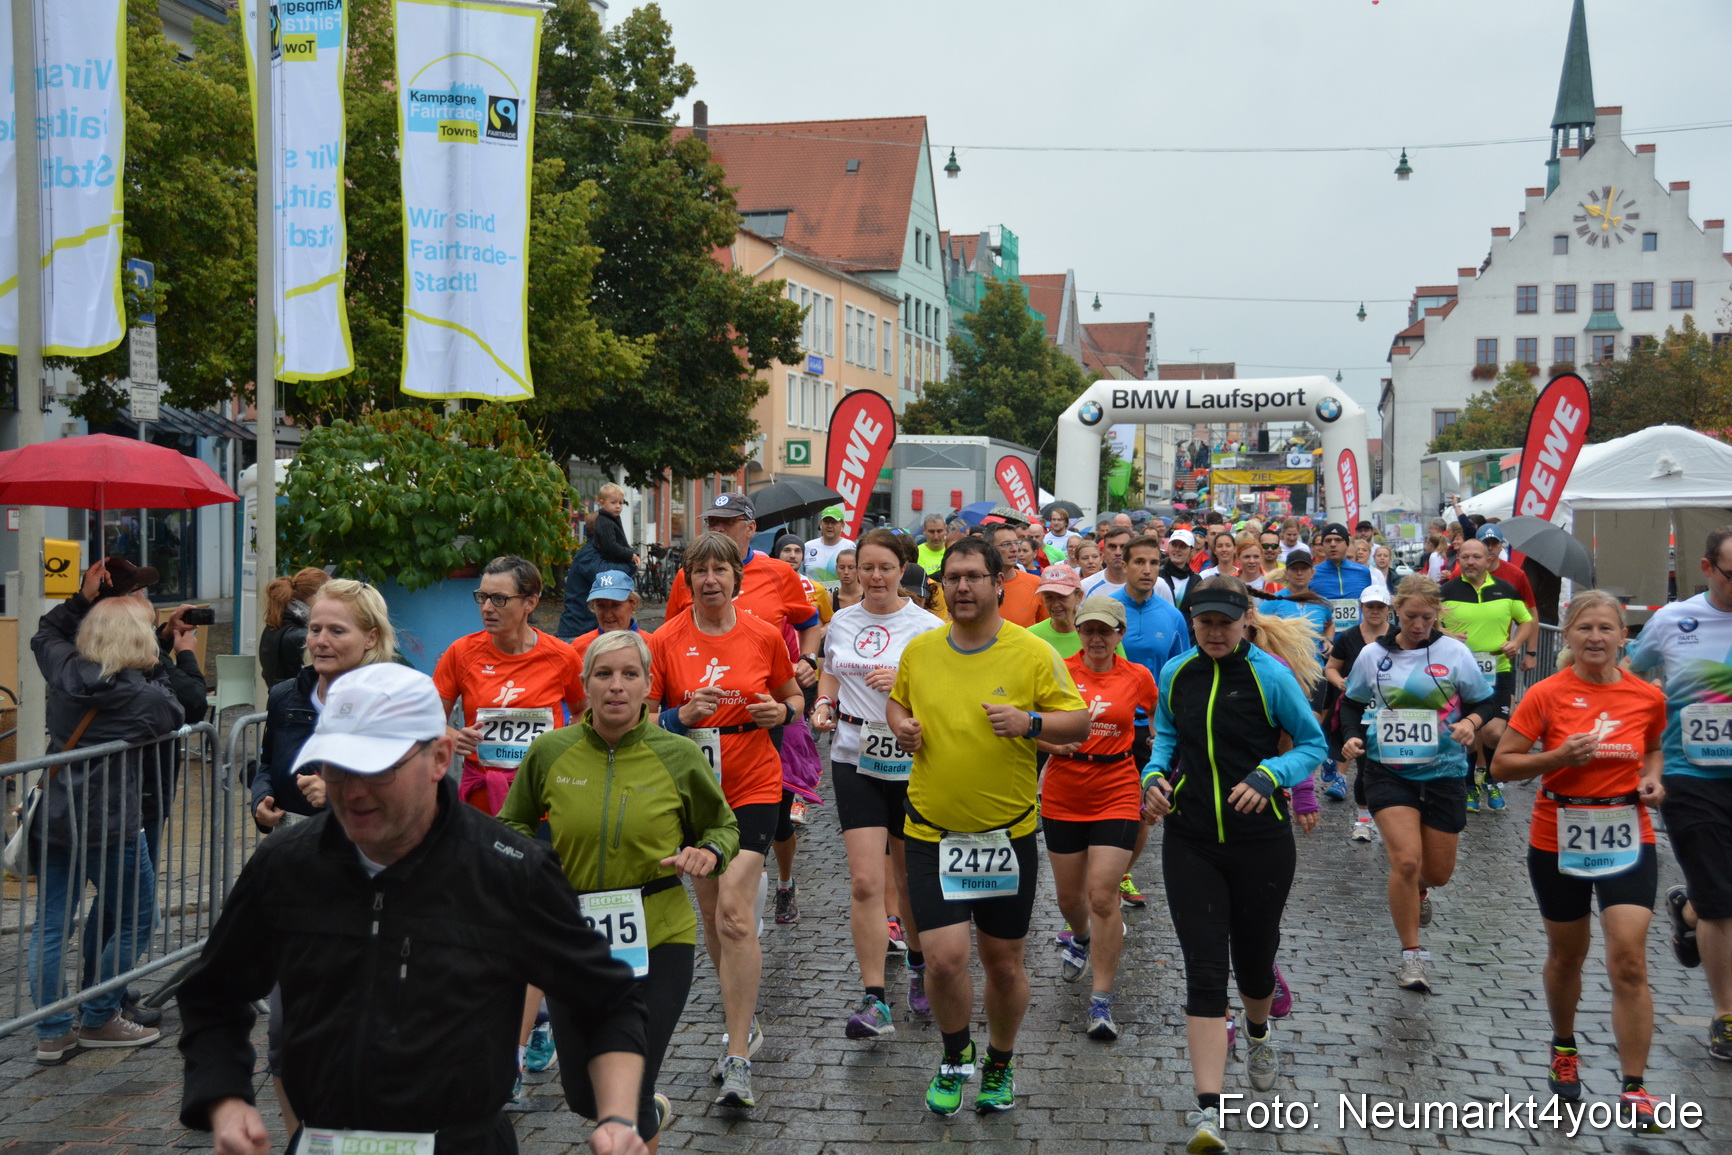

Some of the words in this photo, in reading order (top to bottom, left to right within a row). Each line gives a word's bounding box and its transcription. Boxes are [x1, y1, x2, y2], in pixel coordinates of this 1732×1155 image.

[410, 90, 477, 105] Kampagne
[410, 103, 483, 121] Fairtrade
[440, 125, 478, 138] Towns
[487, 129, 517, 139] FAIRTRADE
[409, 206, 448, 229] Wir
[455, 209, 495, 233] sind
[410, 239, 517, 265] Fairtrade-
[414, 271, 477, 293] Stadt!
[1112, 390, 1179, 409] BMW
[1186, 388, 1306, 412] Laufsport
[790, 444, 807, 461] D
[1520, 395, 1581, 516] REWE
[1251, 472, 1273, 482] ZIEL
[1340, 458, 1357, 519] REWE
[601, 575, 613, 587] NY
[483, 720, 546, 743] 2625
[1383, 723, 1432, 743] 2540
[1400, 748, 1414, 756] Eva
[874, 762, 906, 772] Ricarda
[1567, 823, 1632, 850] 2143
[493, 841, 524, 859] CMP
[948, 847, 1012, 873] 2472
[1583, 857, 1615, 867] Conny
[962, 879, 997, 889] Florian
[589, 893, 634, 907] BOCK
[343, 1137, 417, 1154] BOCK
